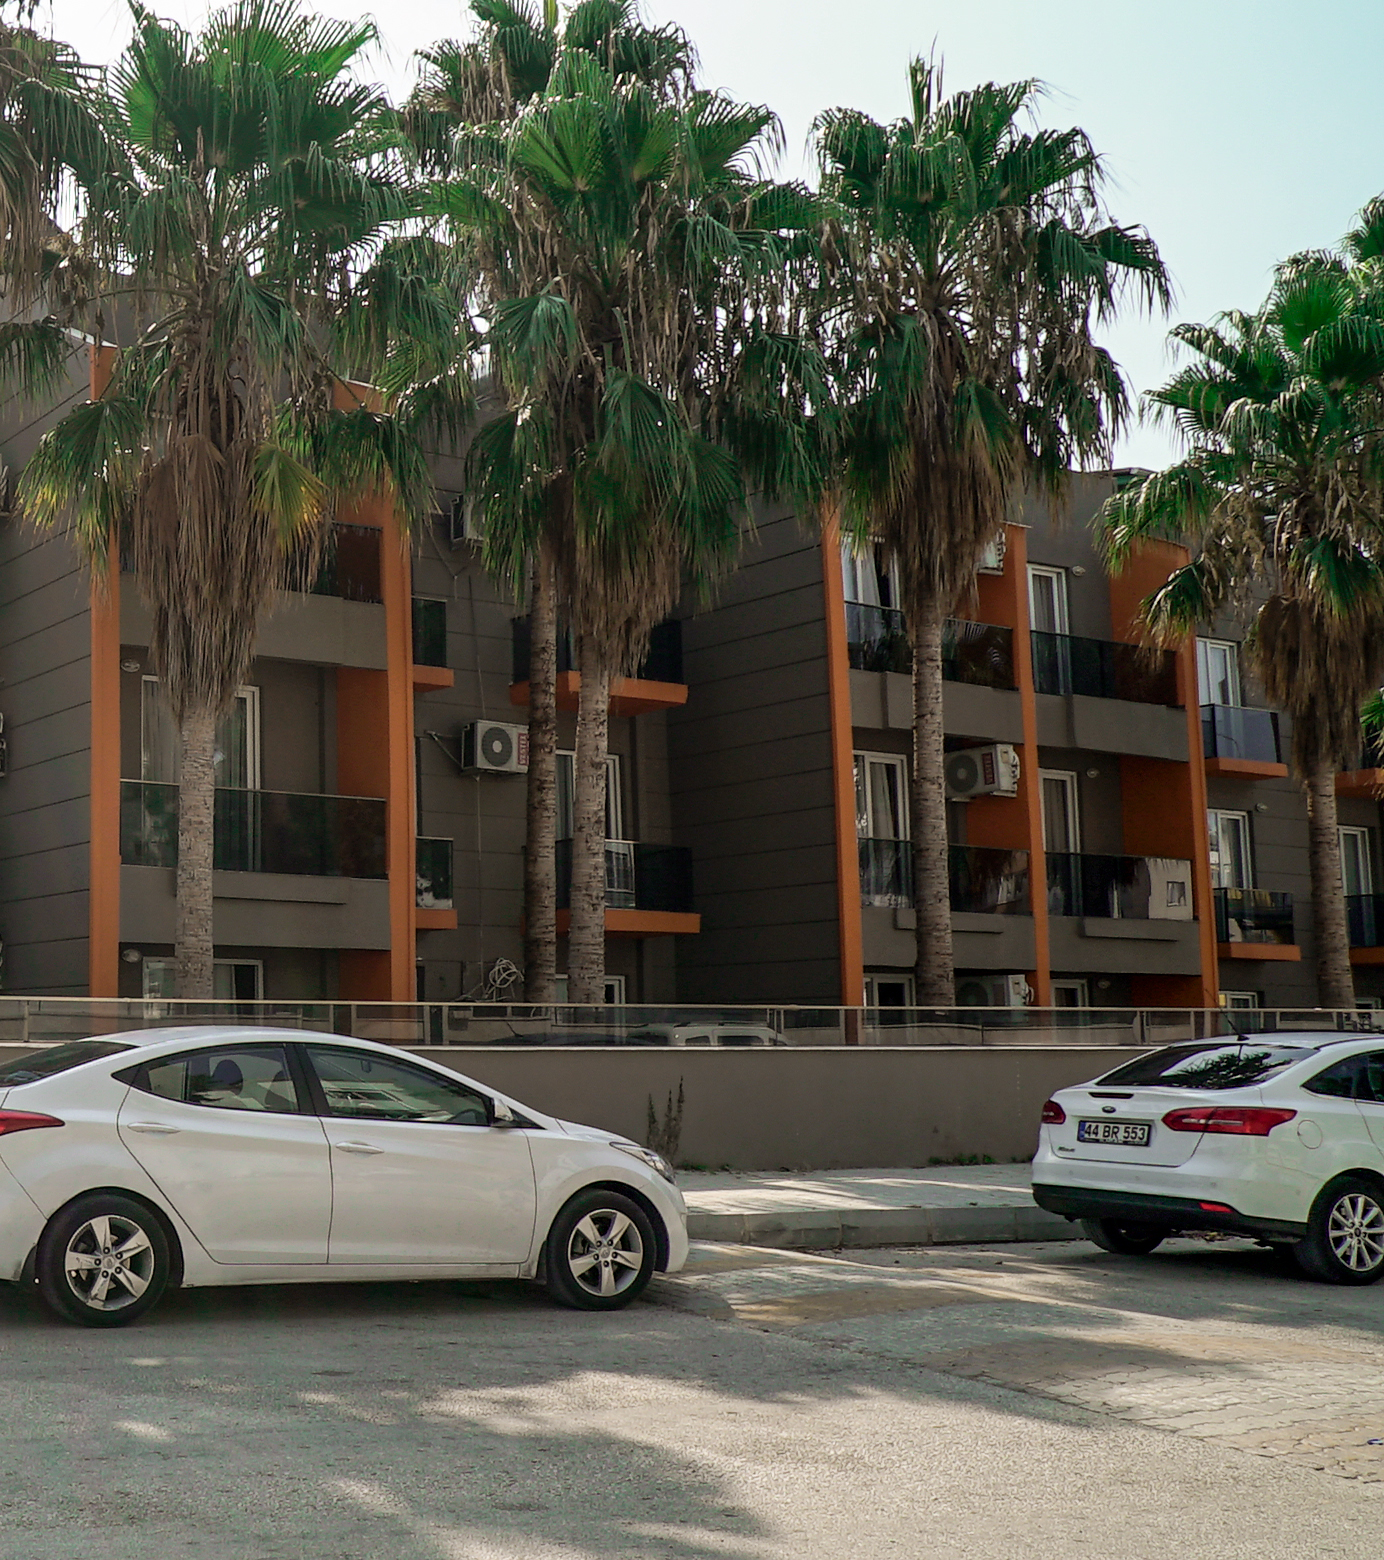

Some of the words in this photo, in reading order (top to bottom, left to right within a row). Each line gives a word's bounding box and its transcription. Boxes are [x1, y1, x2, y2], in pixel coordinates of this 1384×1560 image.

[1084, 1124, 1099, 1138] 44
[1102, 1125, 1120, 1139] BR
[1123, 1126, 1145, 1140] 553
